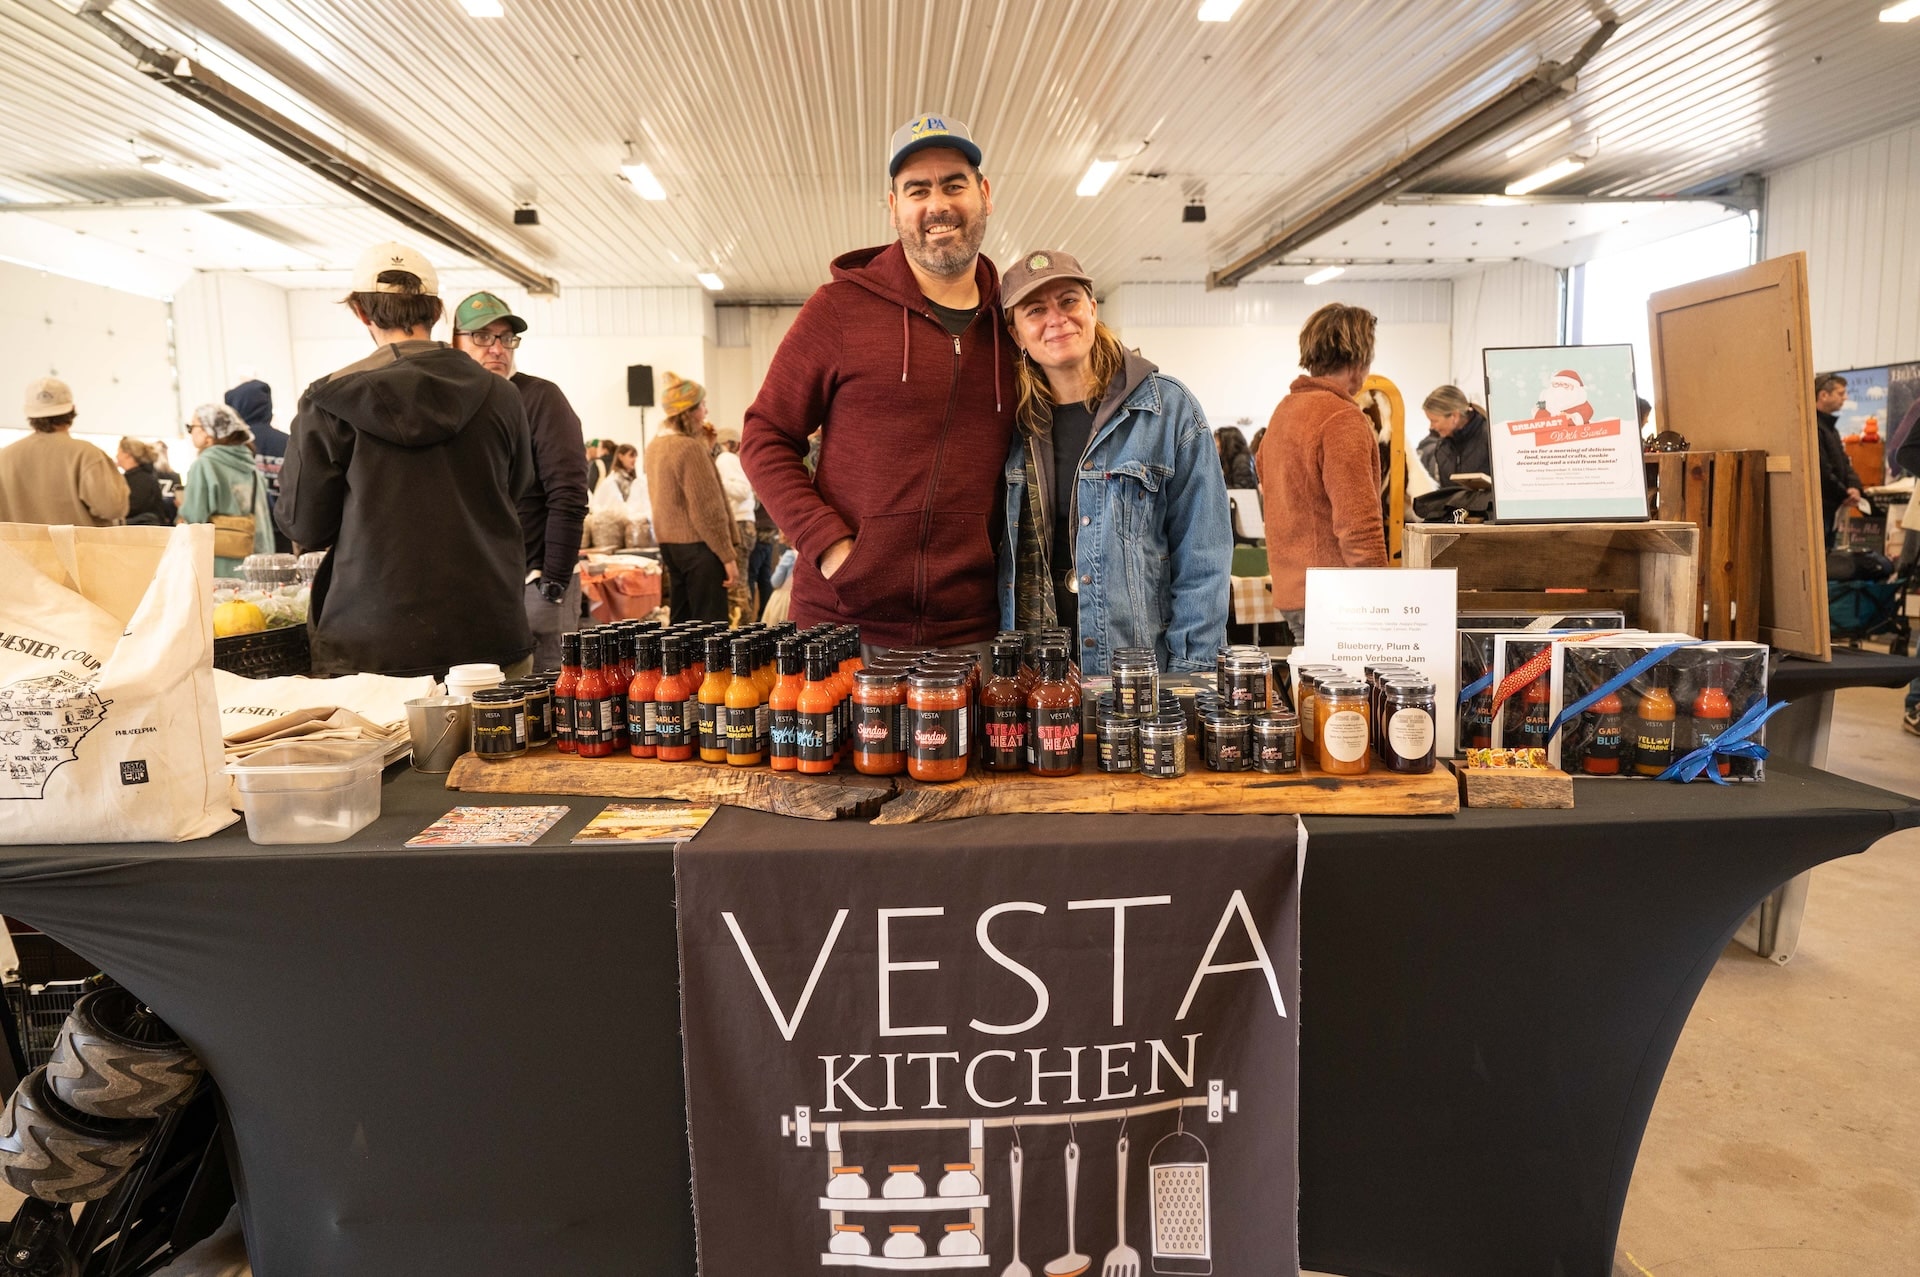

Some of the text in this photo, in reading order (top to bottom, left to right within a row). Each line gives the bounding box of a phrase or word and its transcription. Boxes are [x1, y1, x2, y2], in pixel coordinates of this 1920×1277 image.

[927, 118, 947, 130] PA
[1511, 419, 1563, 432] BREAKFAST
[1550, 426, 1608, 441] With Santa
[1369, 606, 1390, 614] Jam
[1403, 606, 1420, 614] $10
[1337, 641, 1420, 652] Blueberry, Plum &
[1331, 653, 1426, 663] Lemon Verbena Jam
[484, 711, 501, 719] VESTA
[862, 706, 881, 714] VESTA
[996, 711, 1017, 719] VESTA
[774, 715, 794, 723] VESTA
[920, 712, 940, 720] VESTA
[1049, 712, 1071, 720] VESTA
[60, 725, 89, 734] CHESTER
[115, 726, 157, 737] PHILADELPHIA
[655, 723, 682, 734] BLUES
[857, 722, 889, 739] Sunday
[985, 722, 1028, 736] STEAM
[1037, 722, 1080, 739] STEAM
[1524, 724, 1549, 734] BLUE
[773, 732, 797, 744] BLU
[914, 729, 948, 745] Sunday
[990, 734, 1024, 748] HEAT
[1596, 736, 1621, 746] BLUE
[1637, 735, 1671, 745] YELLOW
[1043, 735, 1077, 751] HEAT
[720, 889, 1288, 1042] VESTA
[817, 1031, 1204, 1114] KITCHEN
